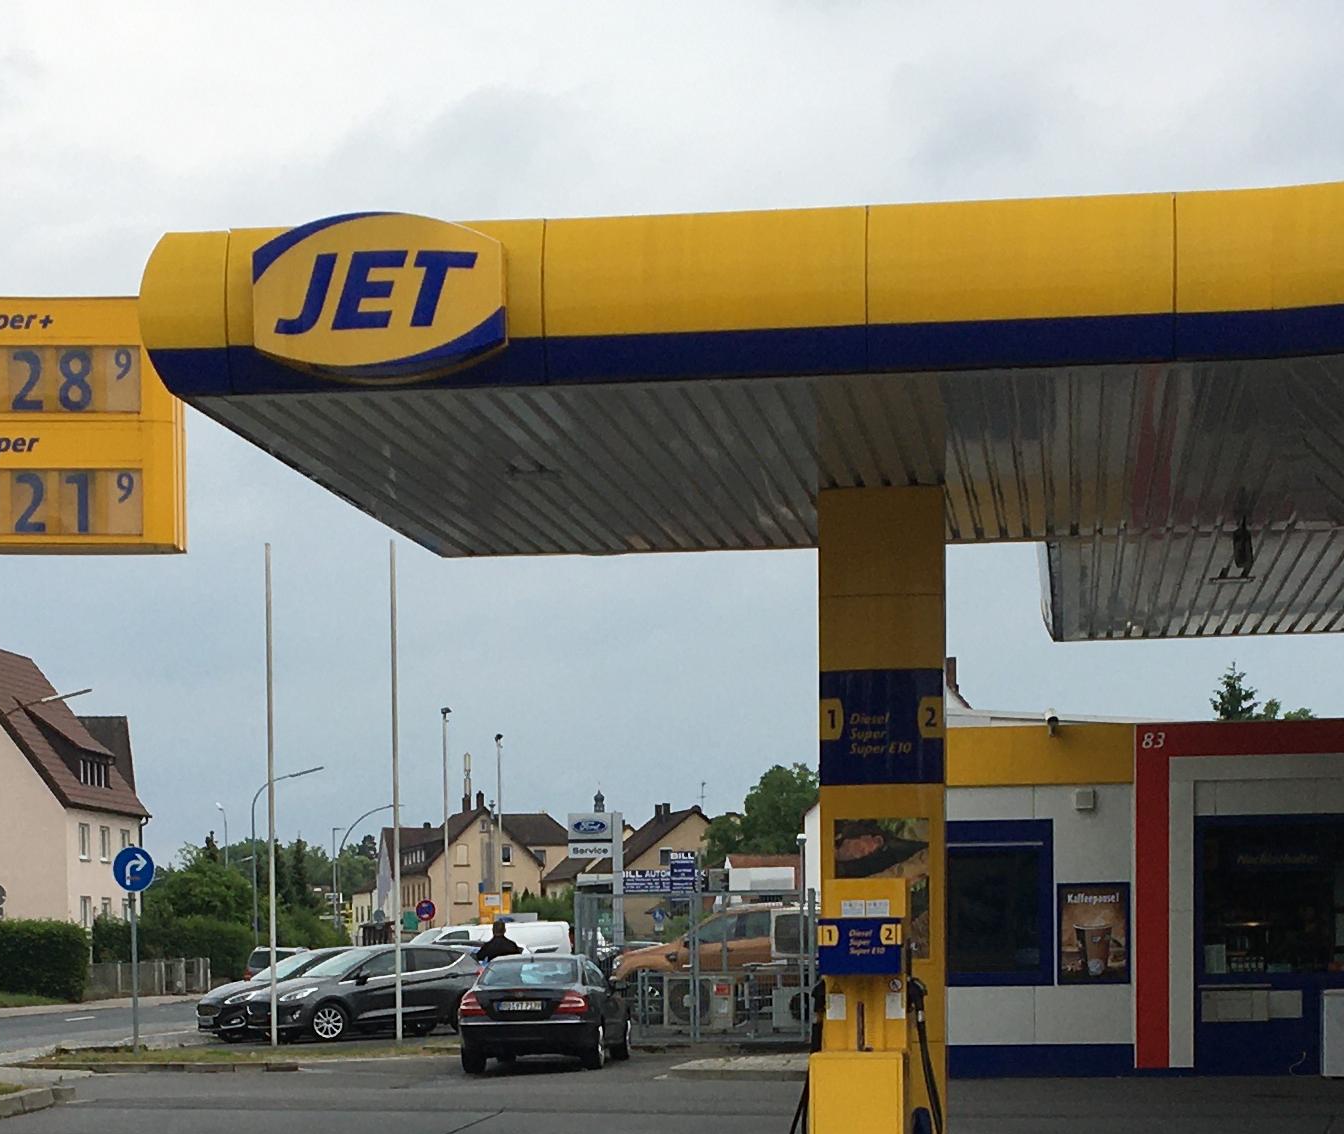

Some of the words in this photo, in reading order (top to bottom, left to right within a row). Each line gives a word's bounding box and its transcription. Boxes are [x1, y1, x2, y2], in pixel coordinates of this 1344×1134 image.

[274, 249, 478, 335] JET
[827, 708, 836, 730] 1
[849, 712, 890, 725] Diesel
[924, 706, 938, 728] 2
[849, 727, 888, 742] Super
[1142, 731, 1167, 749] 83
[849, 742, 886, 758] Super
[572, 847, 609, 855] Service
[670, 852, 695, 860] BILL
[827, 929, 833, 941] 1
[884, 928, 894, 941] 2
